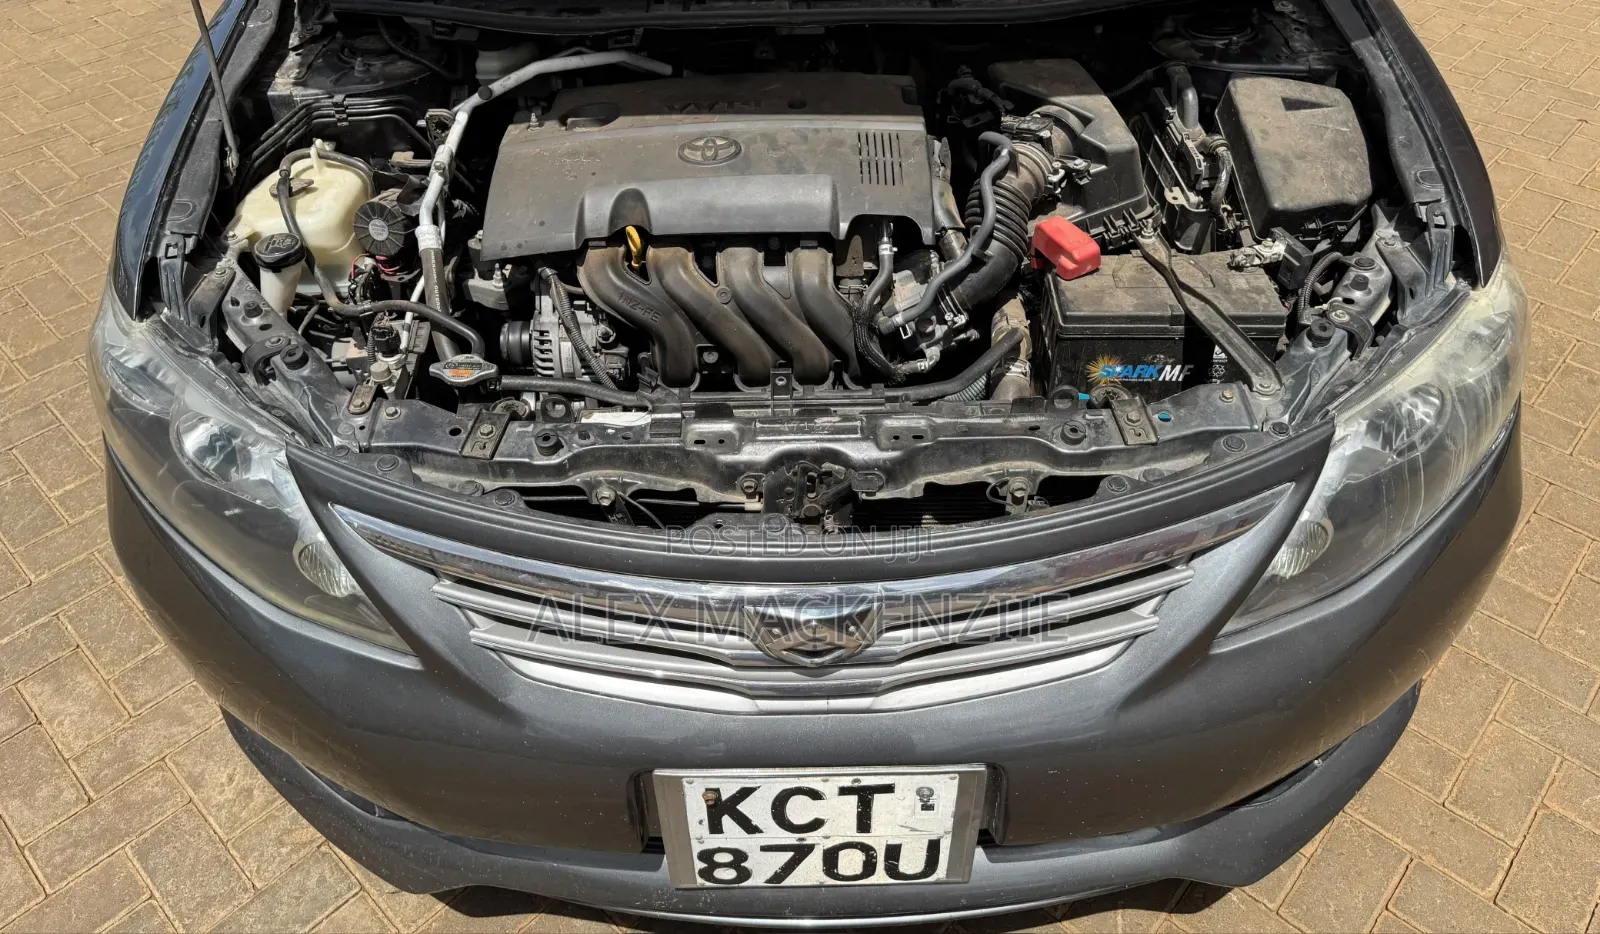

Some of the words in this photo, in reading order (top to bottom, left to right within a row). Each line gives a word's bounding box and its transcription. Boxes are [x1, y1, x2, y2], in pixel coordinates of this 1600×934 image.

[618, 290, 662, 323] 1NZ-FE
[1098, 364, 1163, 379] SPARK
[1158, 364, 1195, 382] MF
[704, 782, 896, 836] KCT
[696, 838, 941, 885] 870U
